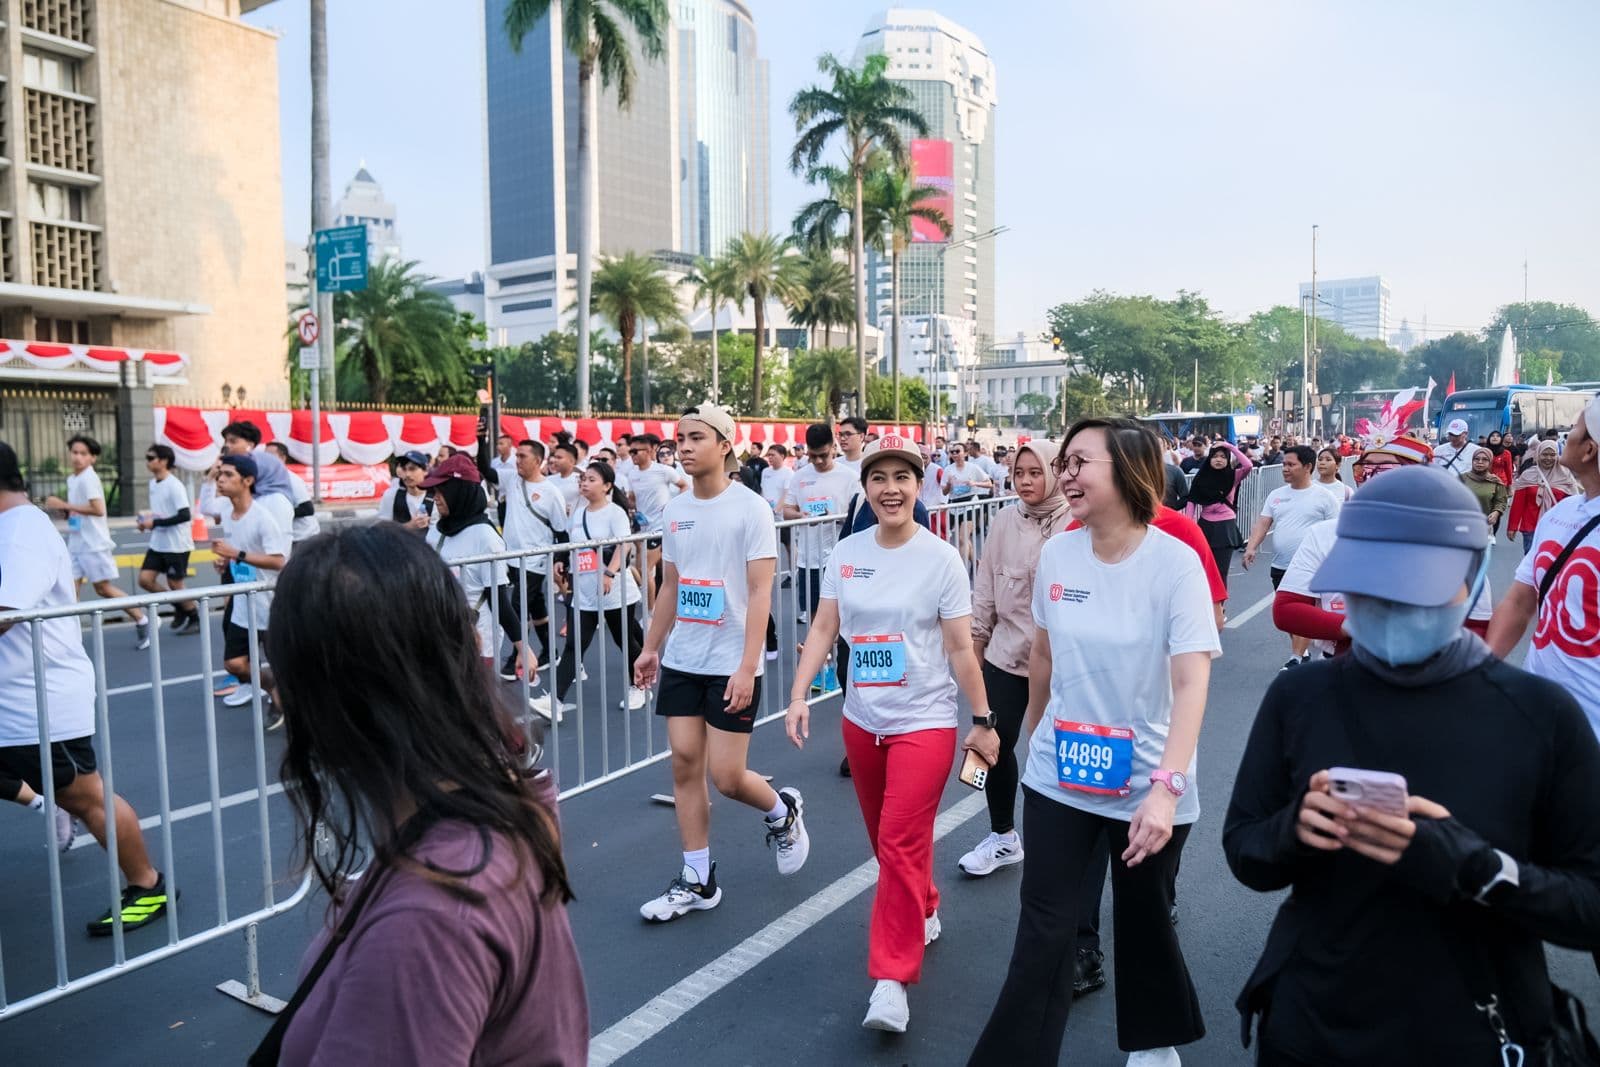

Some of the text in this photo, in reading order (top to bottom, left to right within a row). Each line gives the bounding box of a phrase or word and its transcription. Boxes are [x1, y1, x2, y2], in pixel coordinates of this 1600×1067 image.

[681, 590, 712, 608] 34037
[855, 650, 893, 668] 34038
[1059, 740, 1113, 770] 44899
